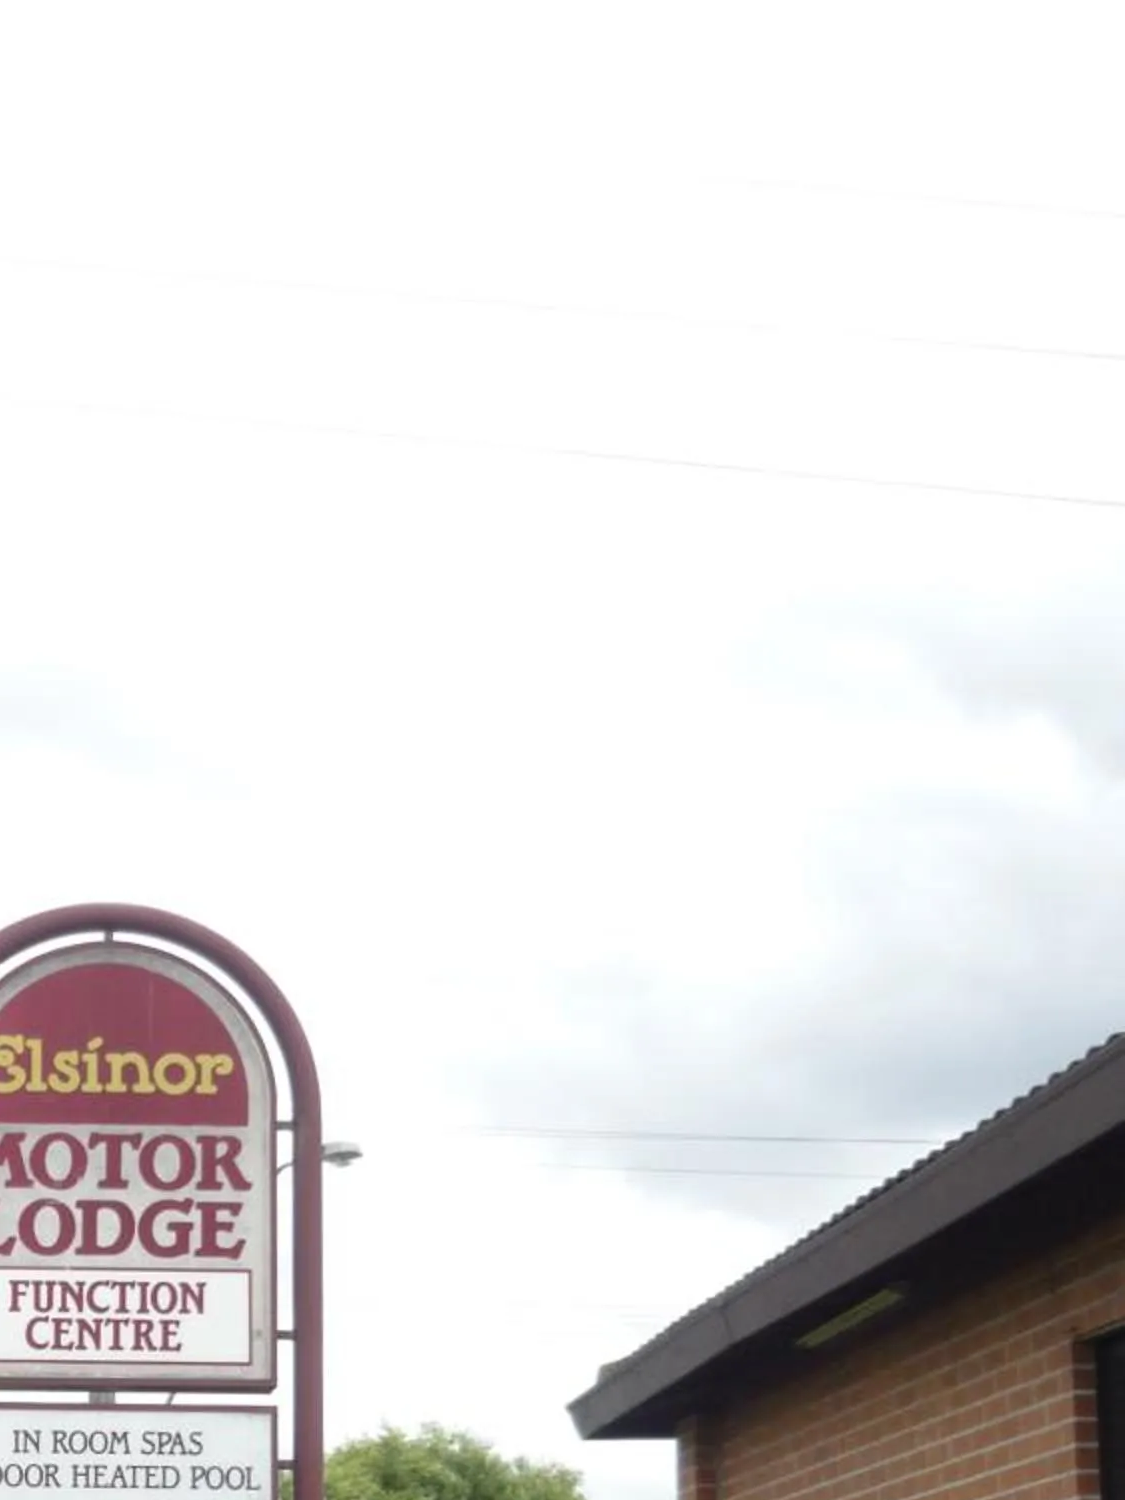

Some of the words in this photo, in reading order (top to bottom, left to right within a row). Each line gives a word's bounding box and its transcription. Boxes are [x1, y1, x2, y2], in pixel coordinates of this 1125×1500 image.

[8, 1279, 207, 1315] FUNCTION
[25, 1317, 183, 1352] CENTRE
[12, 1430, 41, 1454] IN
[52, 1430, 131, 1455] ROOM
[140, 1431, 203, 1455] SPAS
[71, 1465, 180, 1489] HEATED
[190, 1466, 261, 1490] POOL
